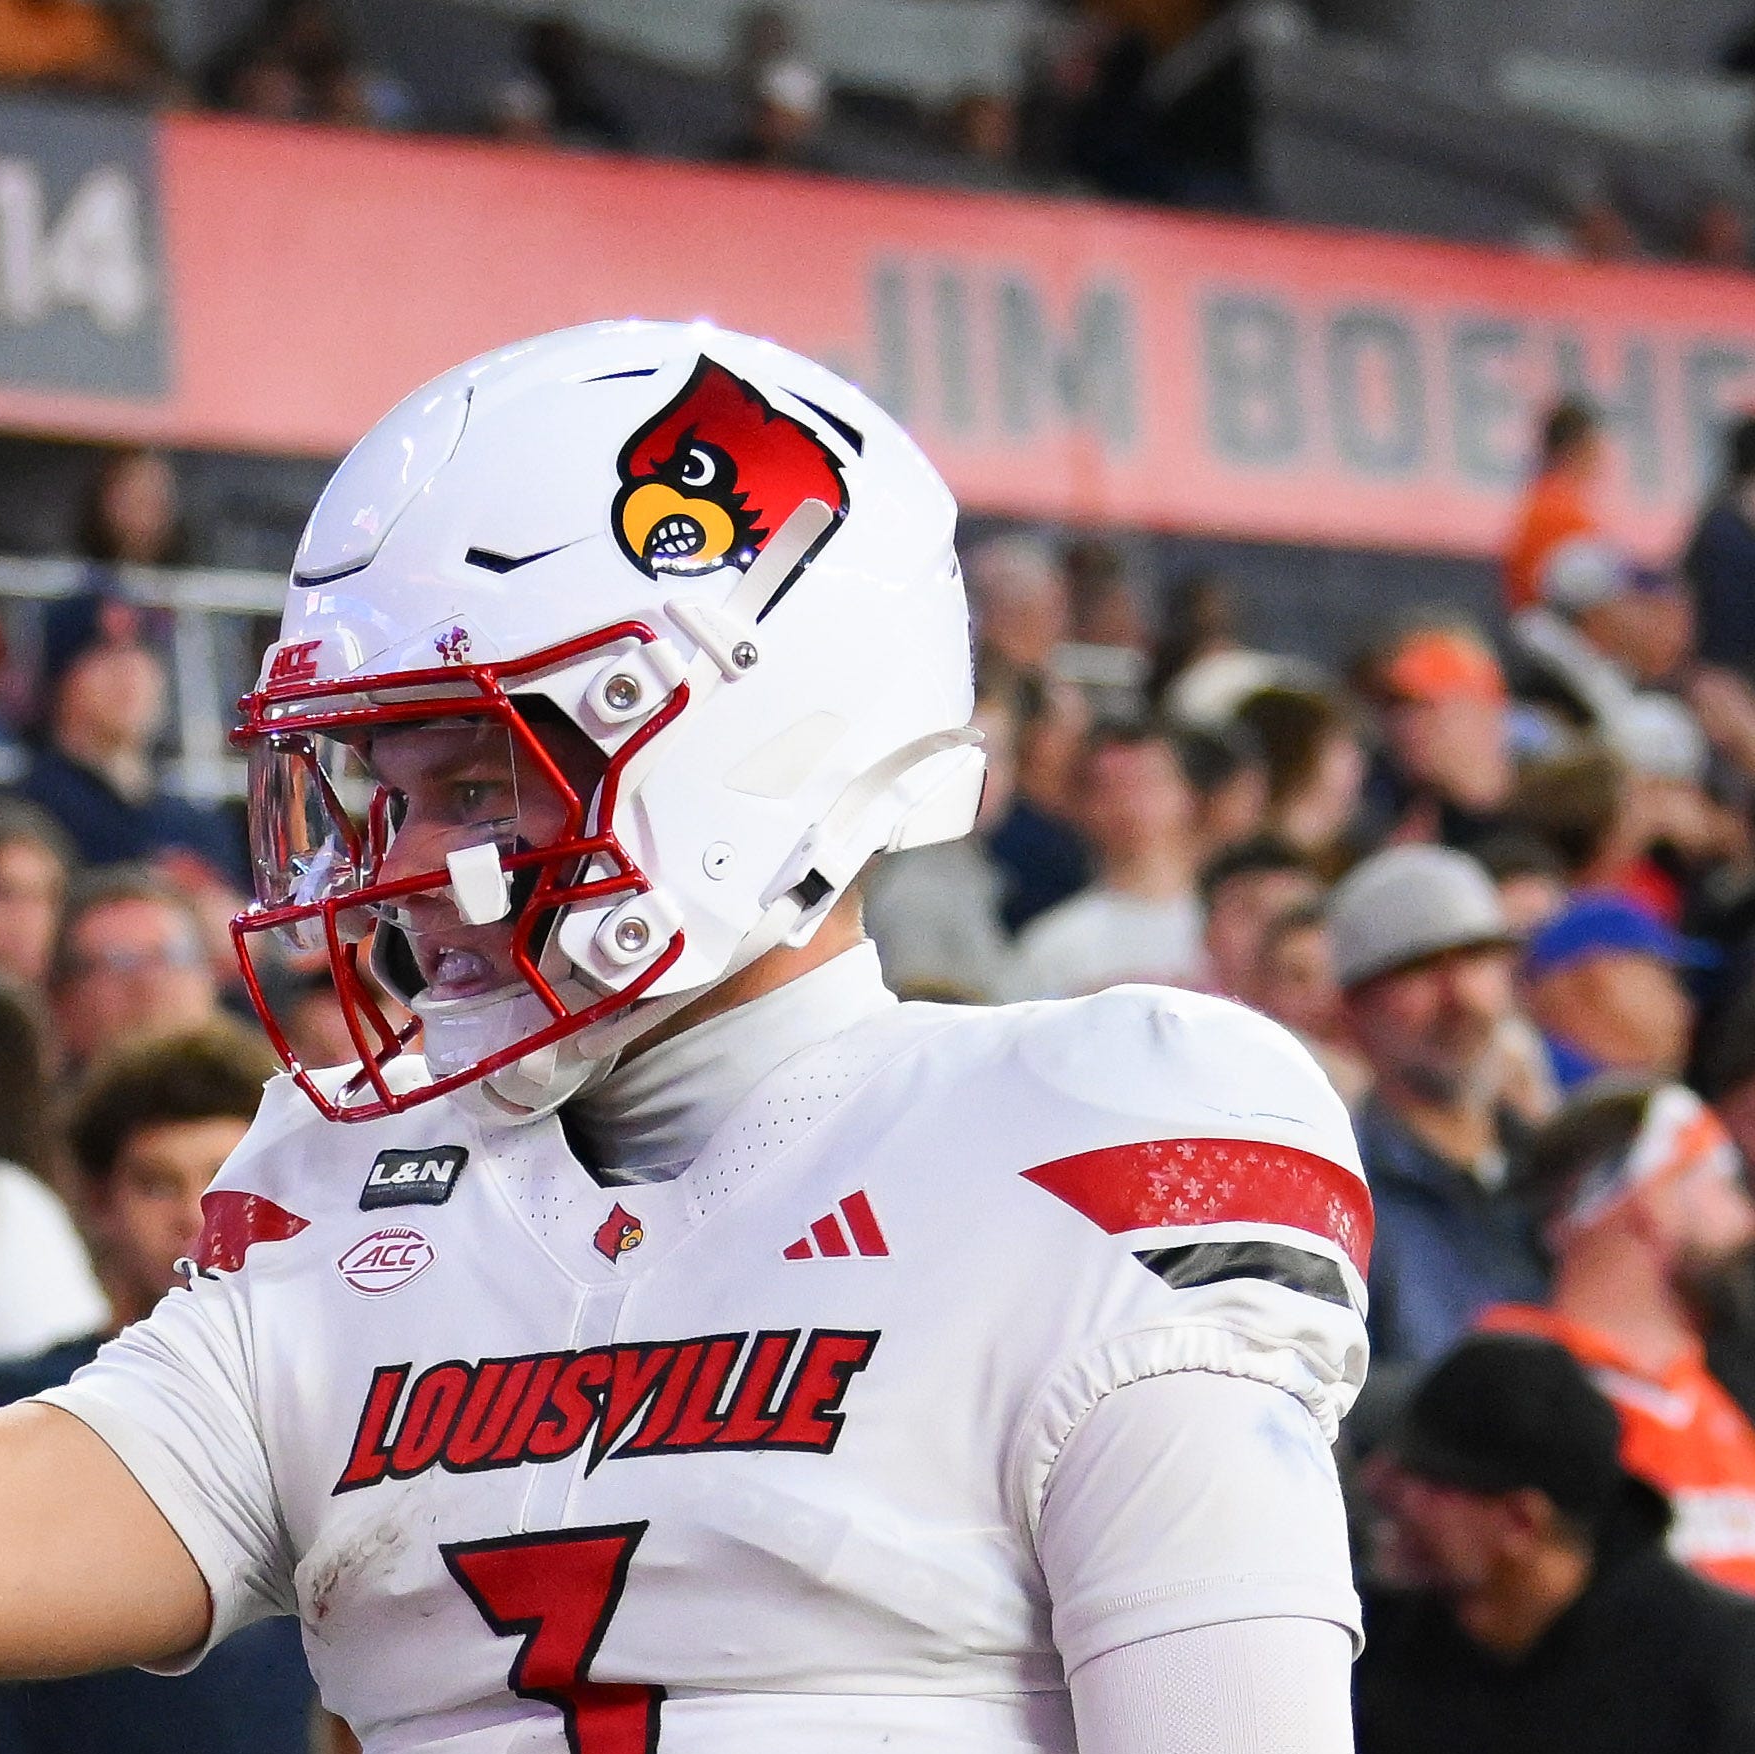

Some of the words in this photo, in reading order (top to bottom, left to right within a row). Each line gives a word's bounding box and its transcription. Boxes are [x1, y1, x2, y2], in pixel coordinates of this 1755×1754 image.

[368, 1160, 455, 1186] L&N
[352, 1243, 426, 1268] ACC
[331, 1329, 882, 1497] LOUISVILLE
